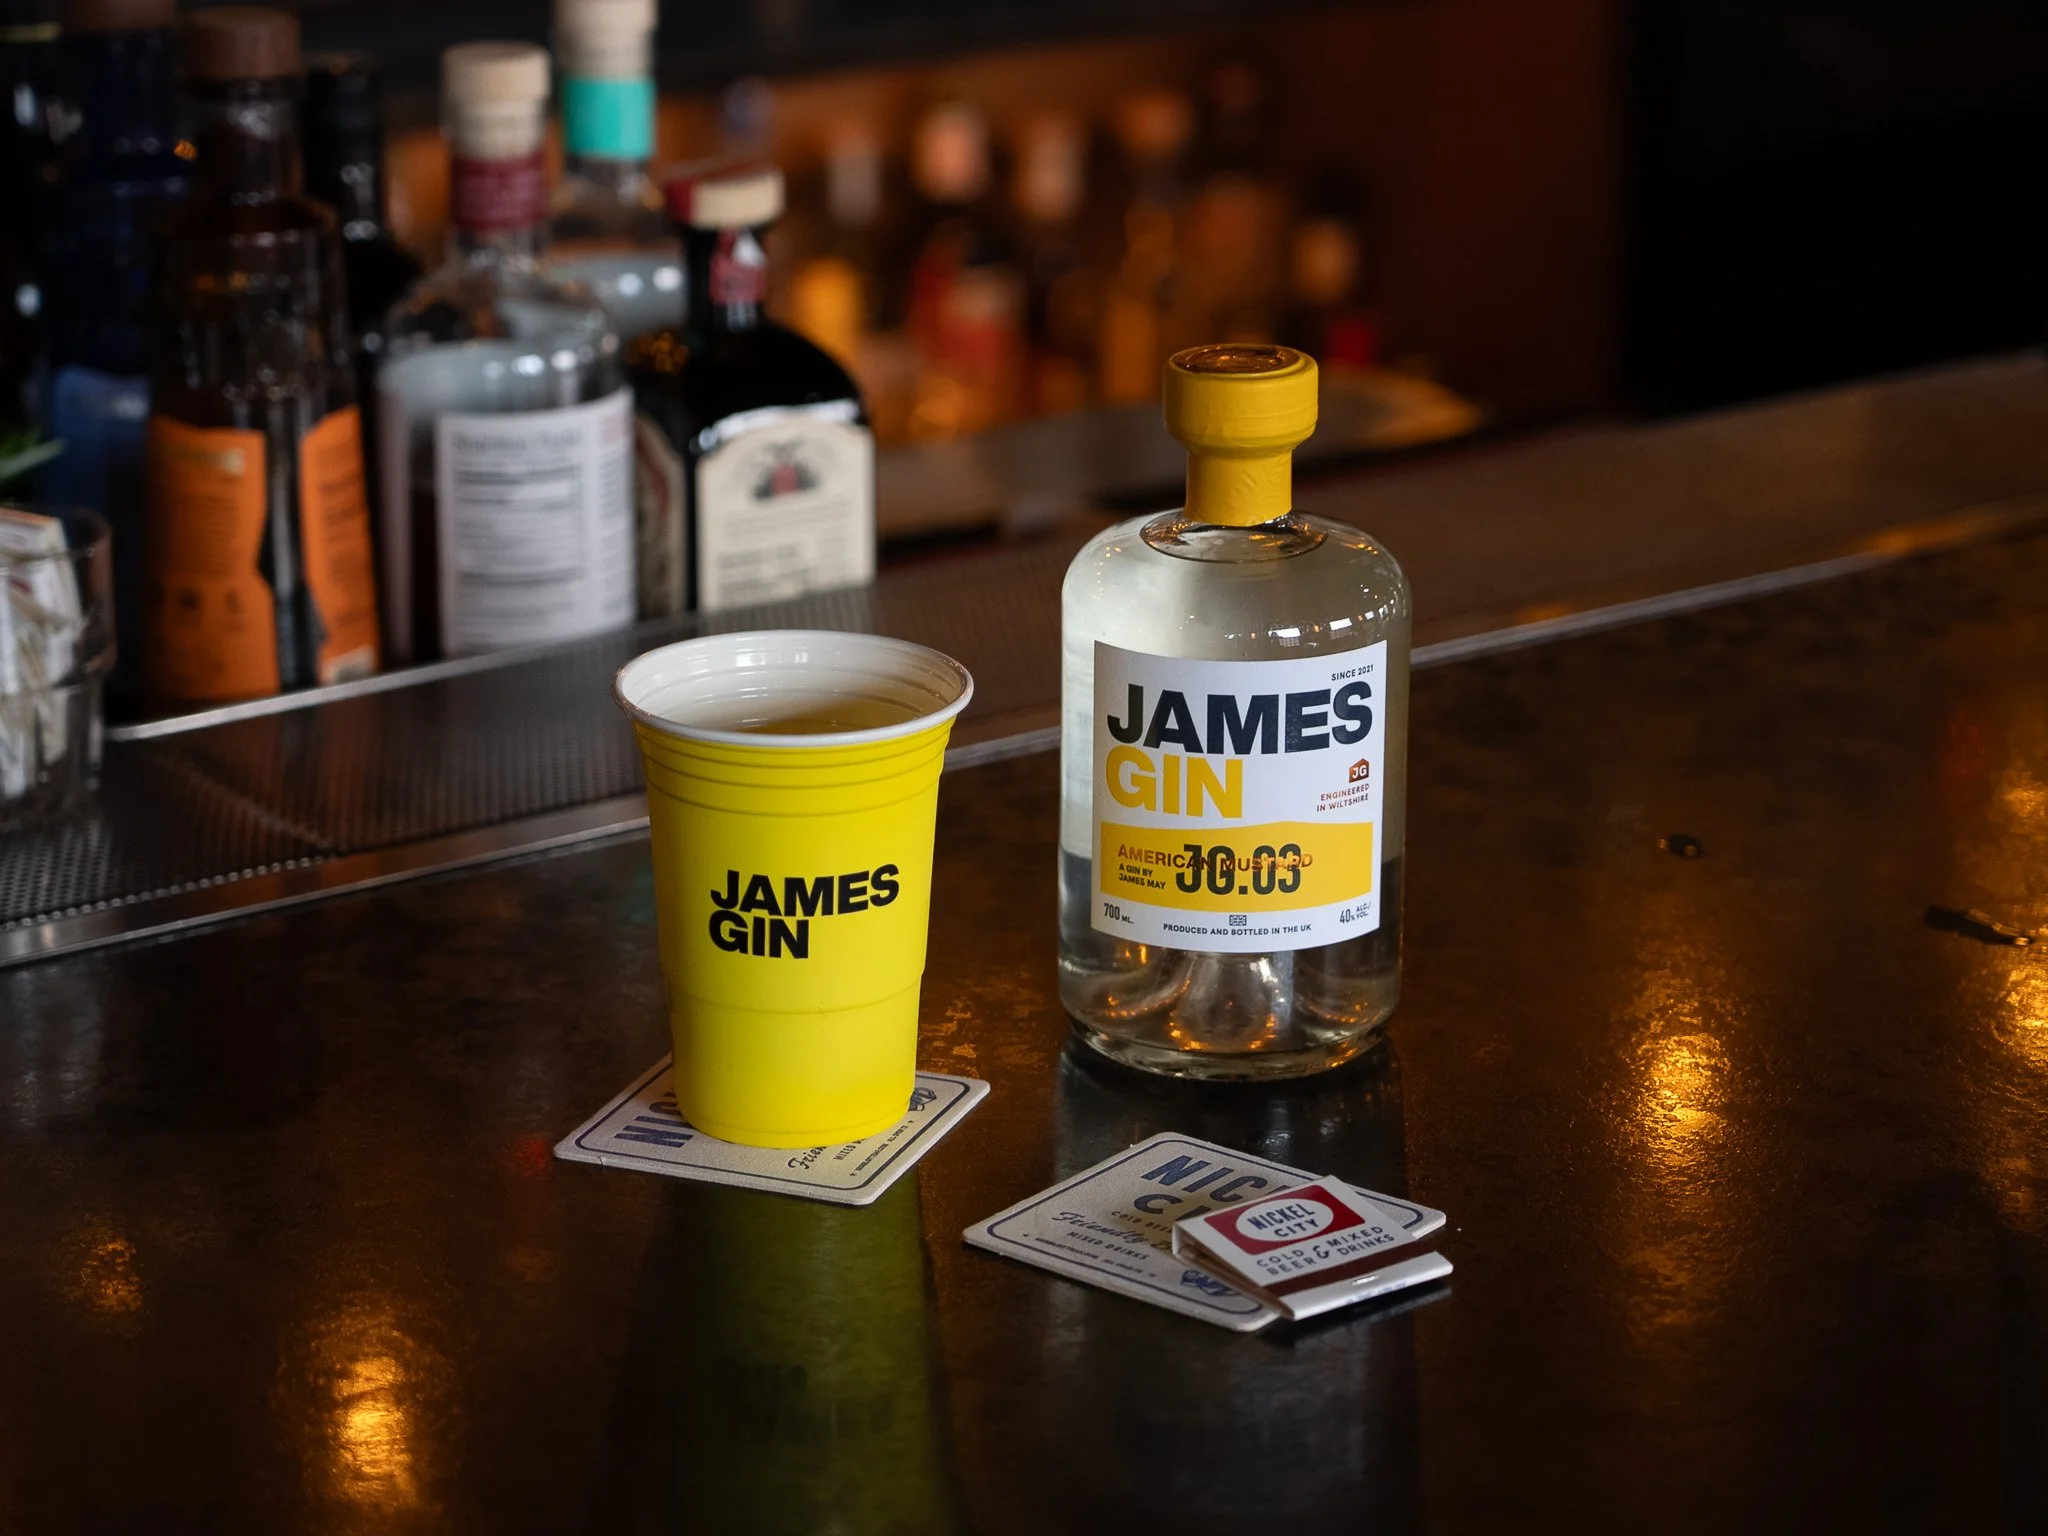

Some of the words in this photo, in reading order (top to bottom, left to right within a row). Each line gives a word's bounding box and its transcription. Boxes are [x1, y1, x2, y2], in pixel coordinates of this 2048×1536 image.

[1331, 669, 1356, 681] SINCE
[1357, 664, 1374, 676] 2021
[1107, 680, 1373, 754] JAMES
[1106, 745, 1243, 818] GIN
[1352, 764, 1368, 779] JG
[1316, 804, 1326, 812] IN
[1329, 793, 1369, 810] WILTSHIRE
[1320, 783, 1370, 801] ENGINEERED
[1117, 844, 1213, 870] AMERICAN
[1220, 853, 1313, 872] MUSTARD
[1119, 863, 1125, 871] A
[1126, 866, 1140, 874] GIN
[1142, 868, 1153, 877] BY
[710, 863, 900, 917] JAMES
[1119, 872, 1145, 886] JAMES
[1147, 879, 1166, 889] MAY
[1104, 902, 1121, 920] 700
[708, 909, 810, 959] GIN
[1163, 923, 1207, 934] PRODUCED
[1210, 927, 1228, 935] AND
[1231, 928, 1269, 936] BOTTLED
[1300, 923, 1312, 931] UK
[1141, 1154, 1290, 1203] NIC
[1052, 1211, 1150, 1244] Friendly
[1111, 1210, 1143, 1224] COLD
[1247, 1203, 1315, 1230] NICKEL
[1274, 1218, 1319, 1238] CITY
[1067, 1231, 1104, 1246] MIXED
[1105, 1243, 1151, 1261] DRINKS
[1256, 1249, 1304, 1268] COLD
[1326, 1226, 1384, 1248] MIXED
[1266, 1256, 1315, 1276] BEER
[1336, 1233, 1395, 1256] DRINKS
